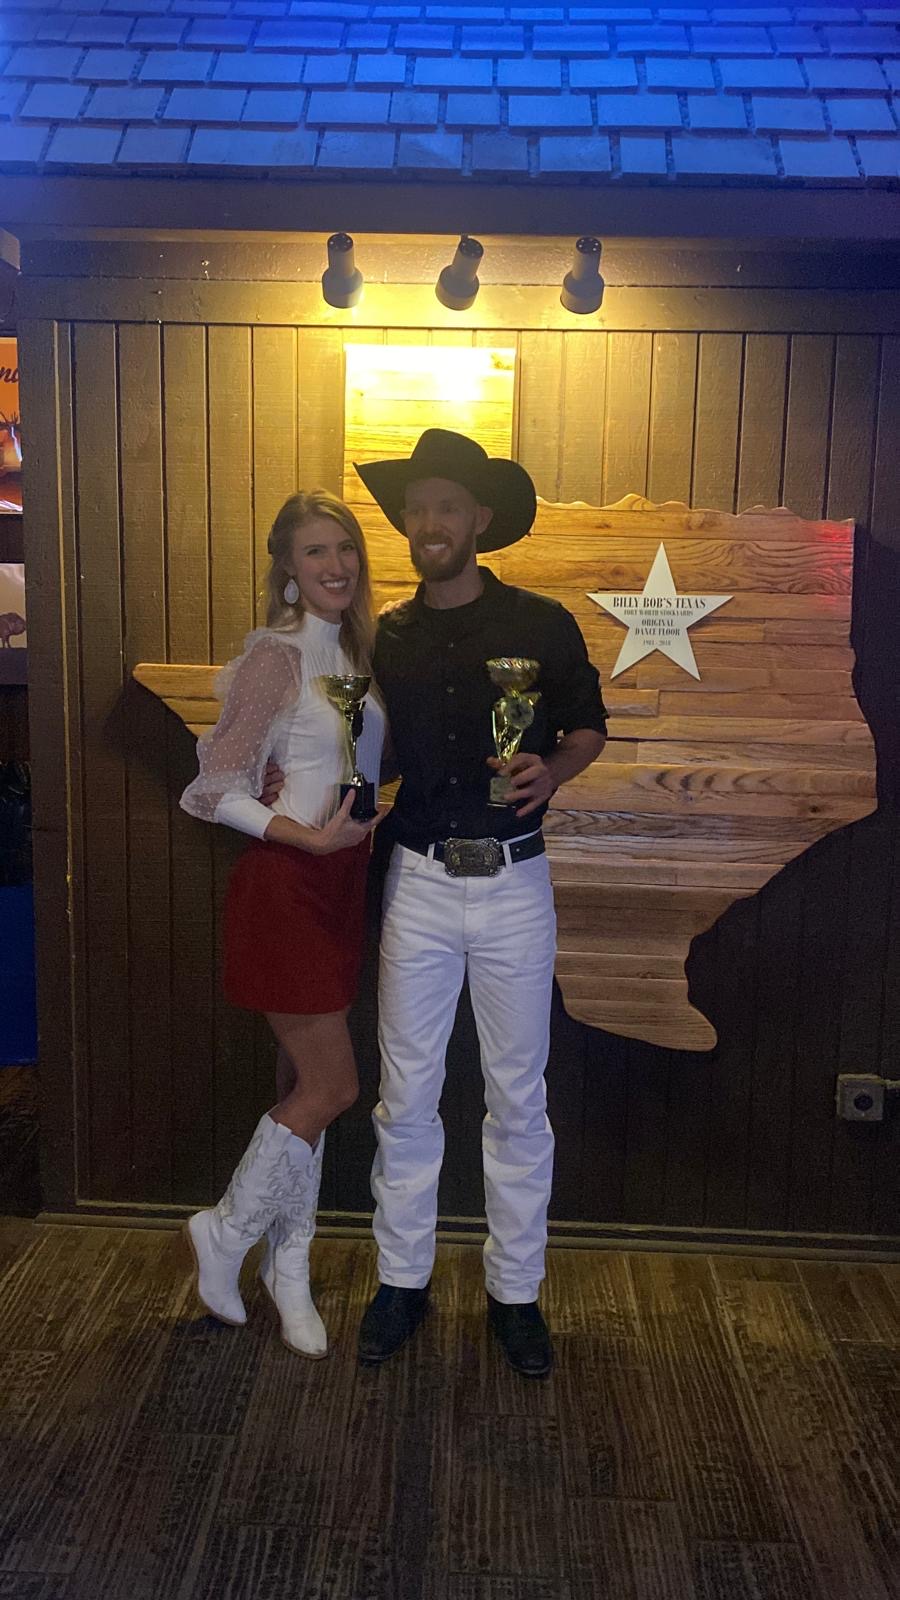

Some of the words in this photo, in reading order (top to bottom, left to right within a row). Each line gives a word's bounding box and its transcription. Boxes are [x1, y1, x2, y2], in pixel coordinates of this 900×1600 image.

[613, 597, 639, 608] BILLY
[643, 597, 672, 608] BOB'S
[676, 598, 706, 609] TEXAS
[641, 619, 674, 627] ORIGINAL
[635, 627, 656, 635] DANCE
[658, 627, 680, 636] FLOOR
